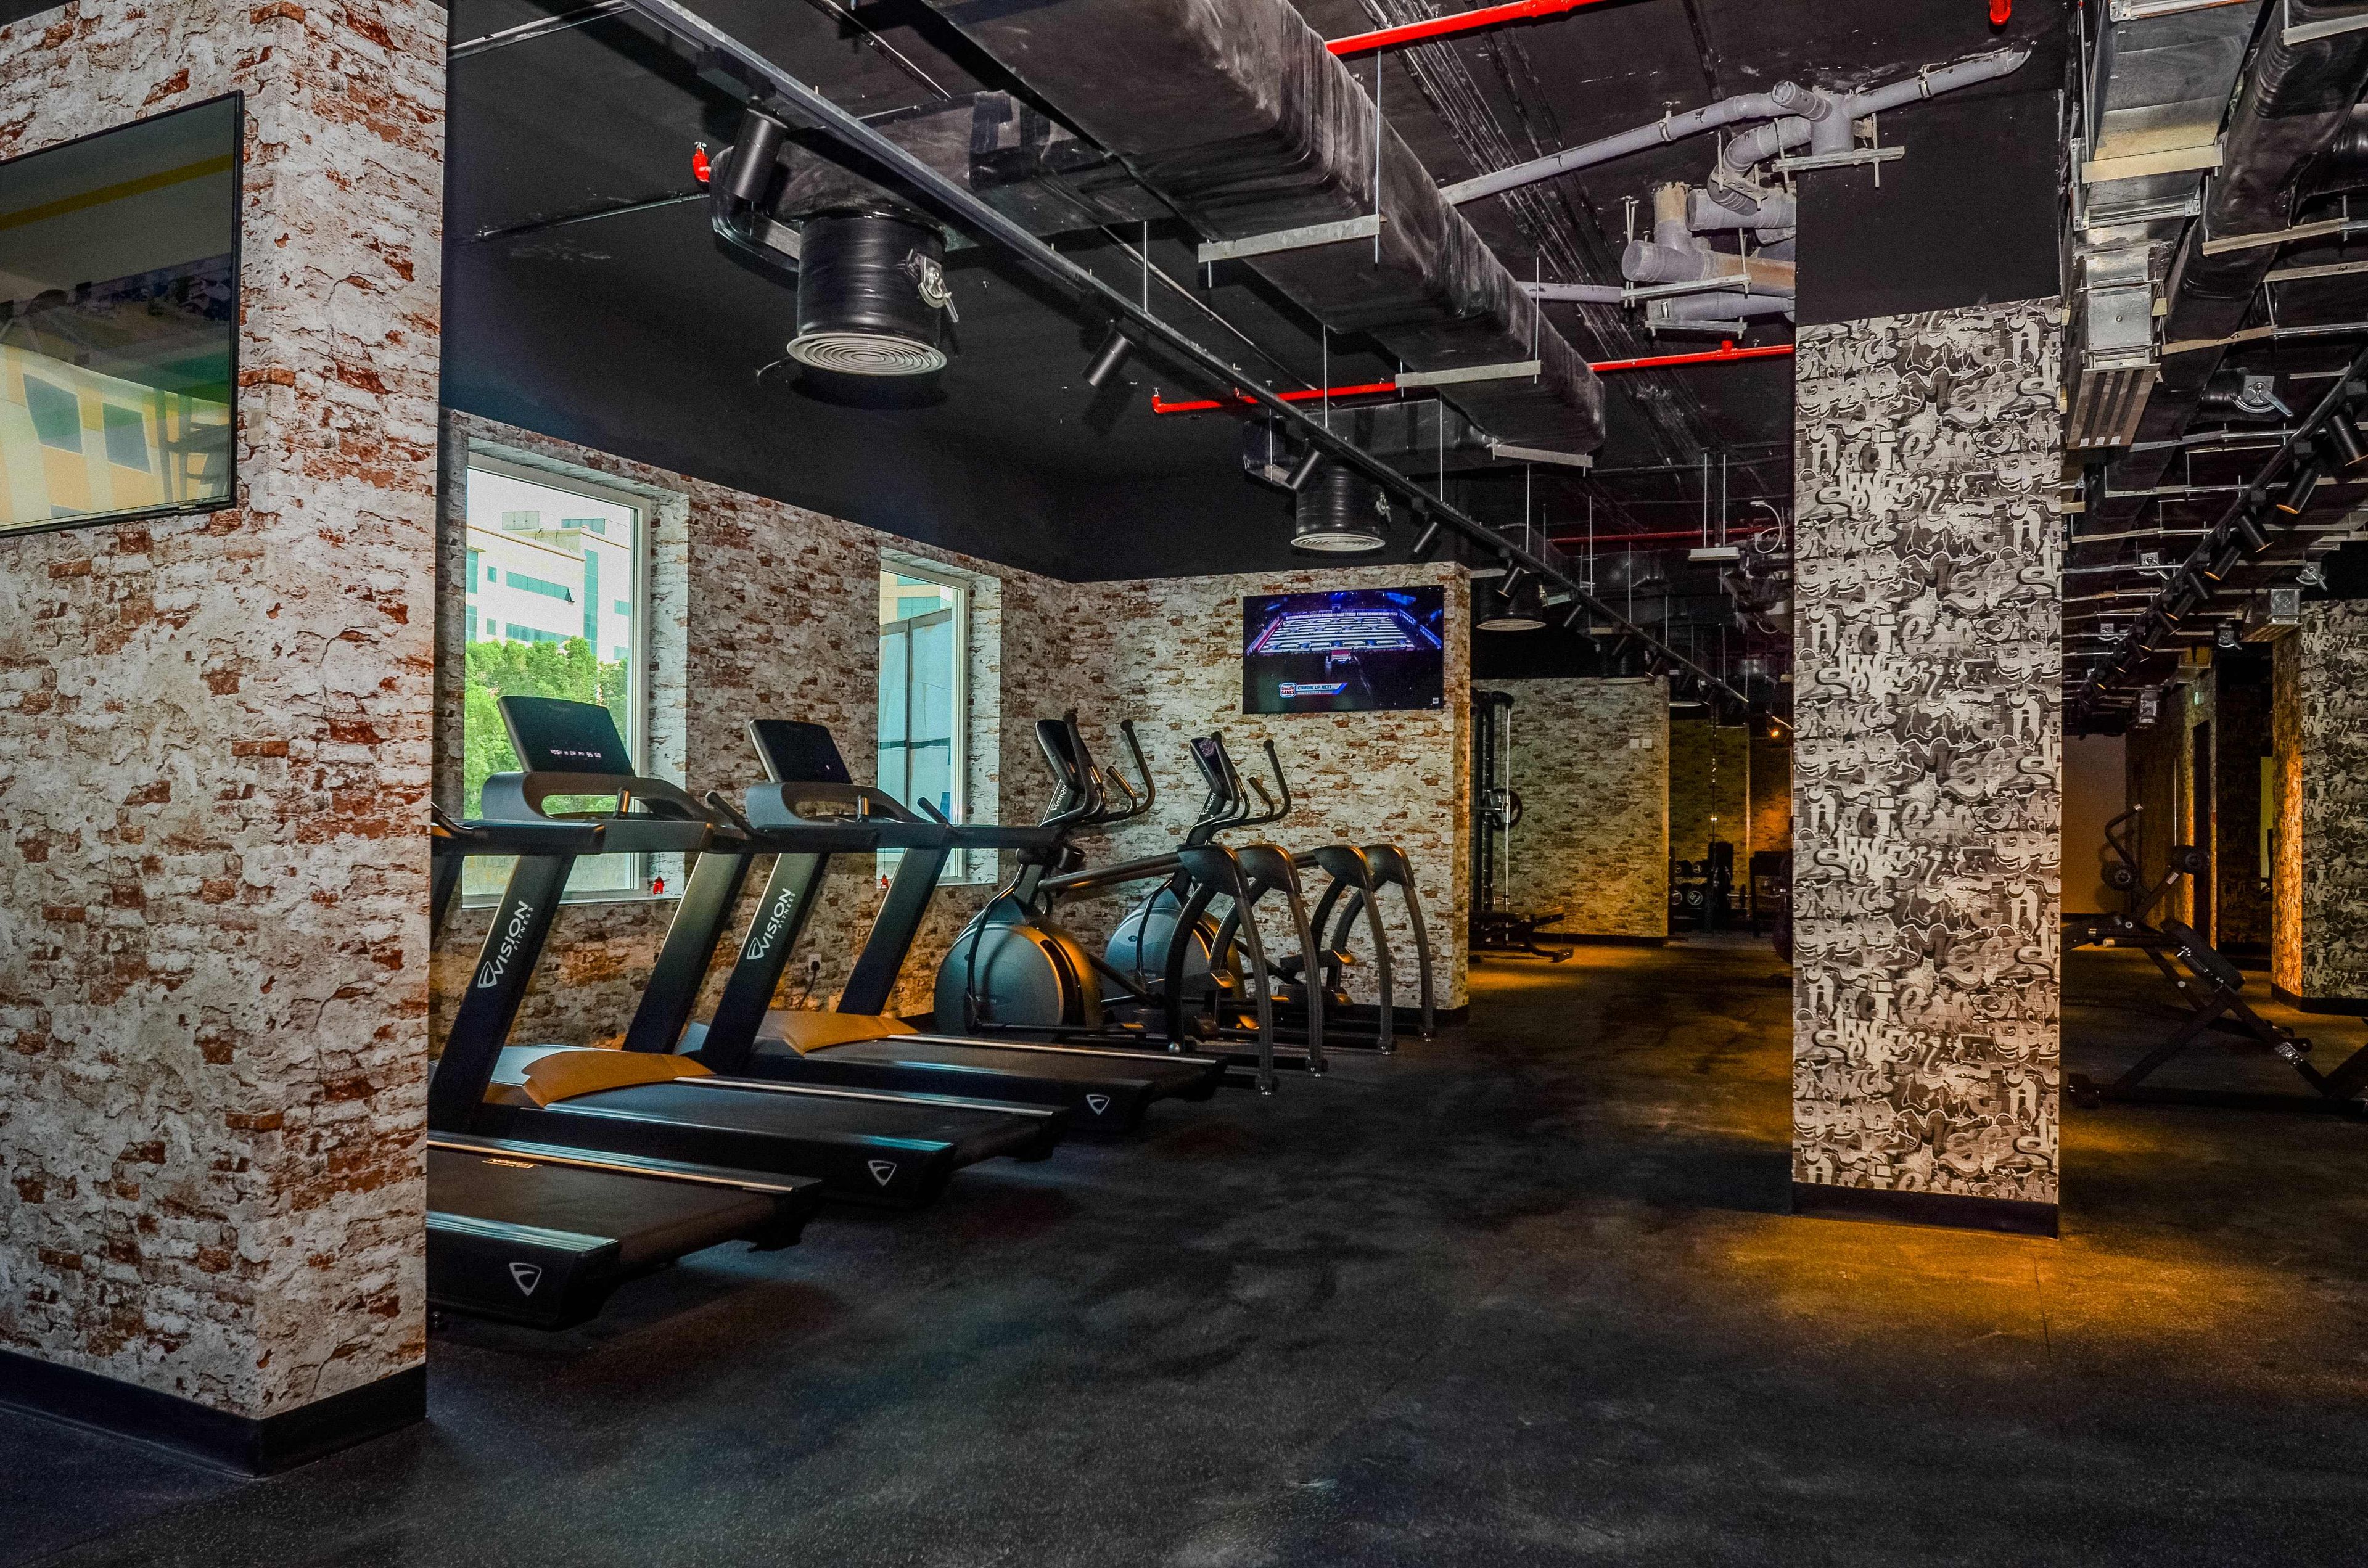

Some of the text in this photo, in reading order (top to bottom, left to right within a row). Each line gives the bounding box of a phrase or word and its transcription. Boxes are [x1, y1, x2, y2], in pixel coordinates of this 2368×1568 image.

[1055, 784, 1067, 807] VISION
[1206, 792, 1215, 811] VISION
[514, 907, 533, 950] FITNESS
[760, 888, 792, 948] VISION
[778, 893, 796, 929] FITNESS
[495, 900, 529, 974] VISION
